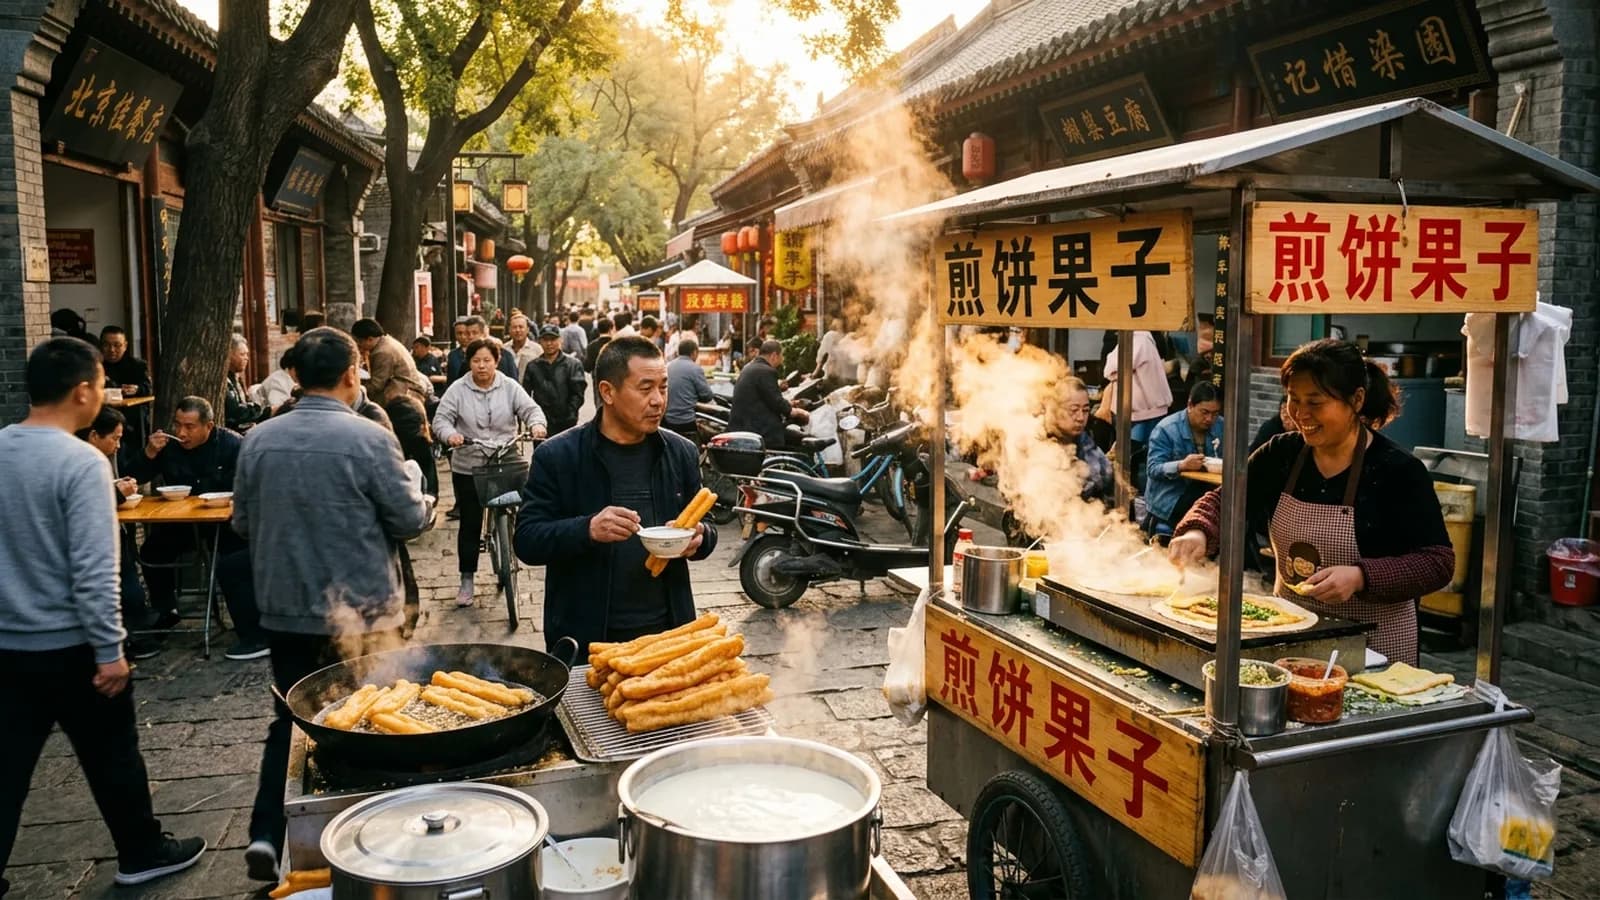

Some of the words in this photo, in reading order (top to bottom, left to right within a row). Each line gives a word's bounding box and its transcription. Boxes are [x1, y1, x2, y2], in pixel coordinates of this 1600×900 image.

[944, 227, 1171, 318] 煎饼果子
[1268, 211, 1532, 303] 煎饼果子
[940, 628, 1169, 819] 煎饼果子
